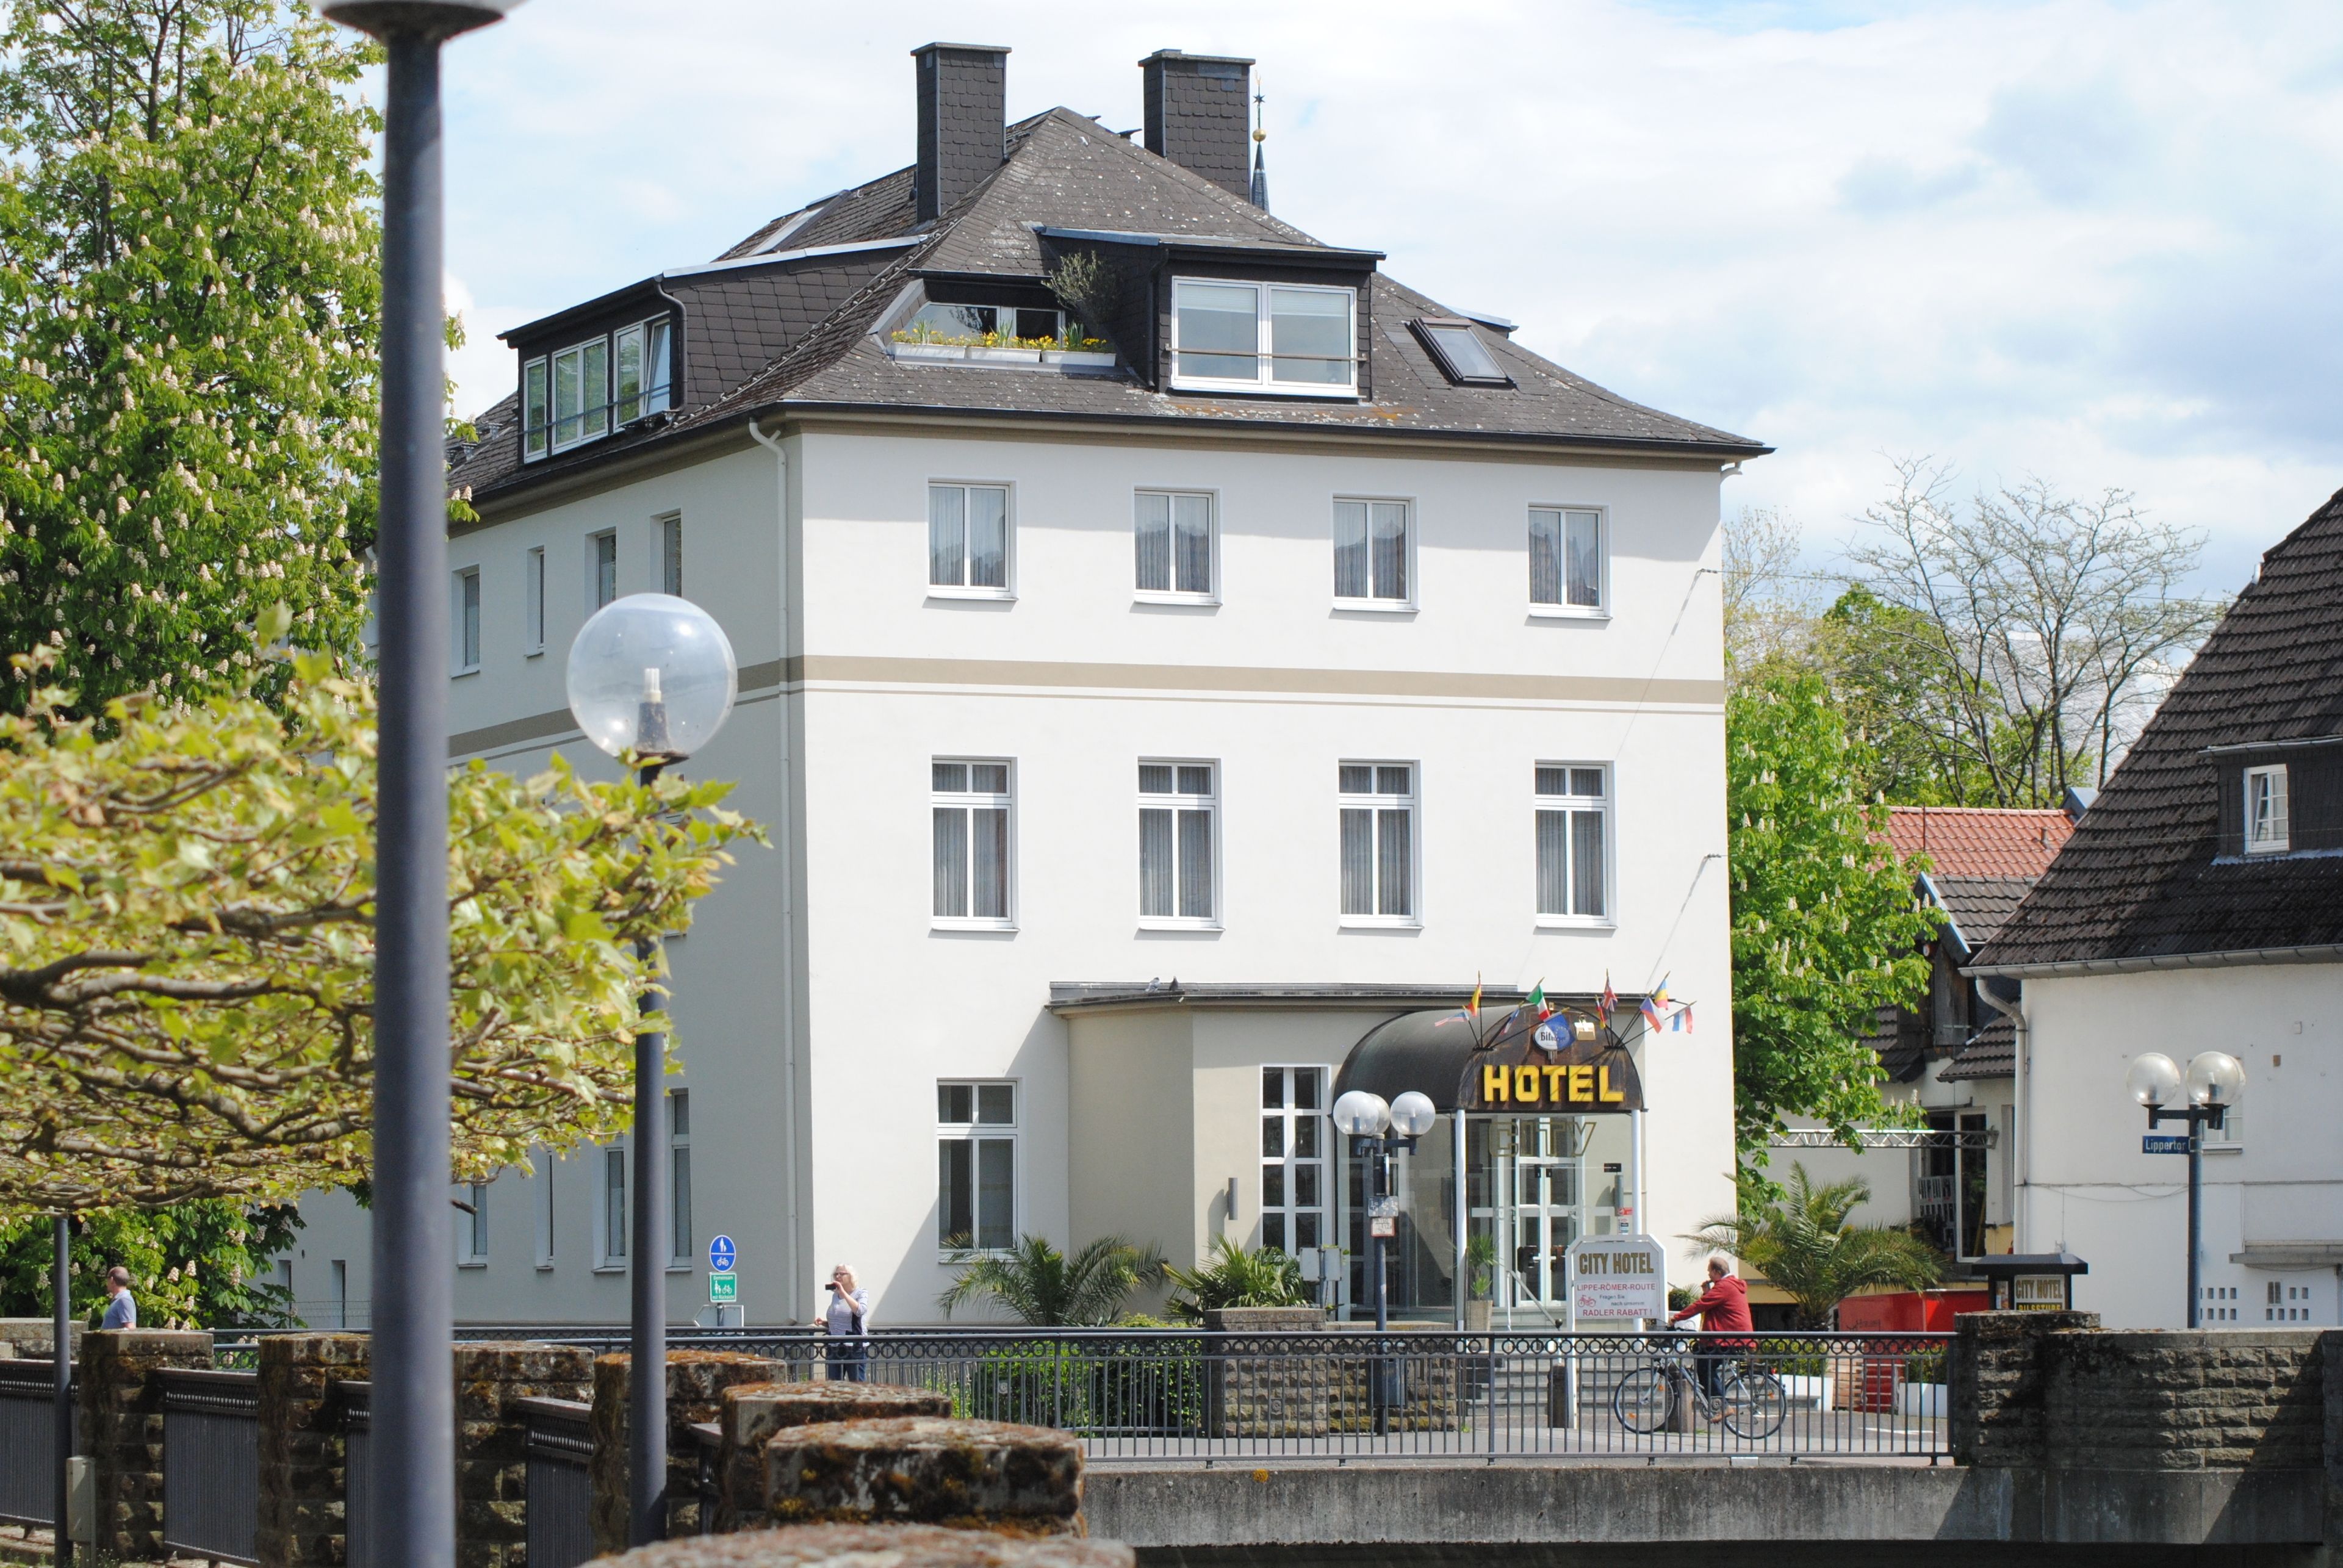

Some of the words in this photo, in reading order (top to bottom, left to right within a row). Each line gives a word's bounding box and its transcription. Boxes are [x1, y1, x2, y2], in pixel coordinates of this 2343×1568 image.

[1483, 1065, 1624, 1102] HOTEL
[1488, 1121, 1597, 1157] CITY
[2145, 1138, 2186, 1153] Lippertor
[1579, 1253, 1609, 1275] CITY
[1613, 1252, 1654, 1274] HOTEL
[2015, 1279, 2035, 1299] CITY
[2037, 1279, 2063, 1299] HOTEL
